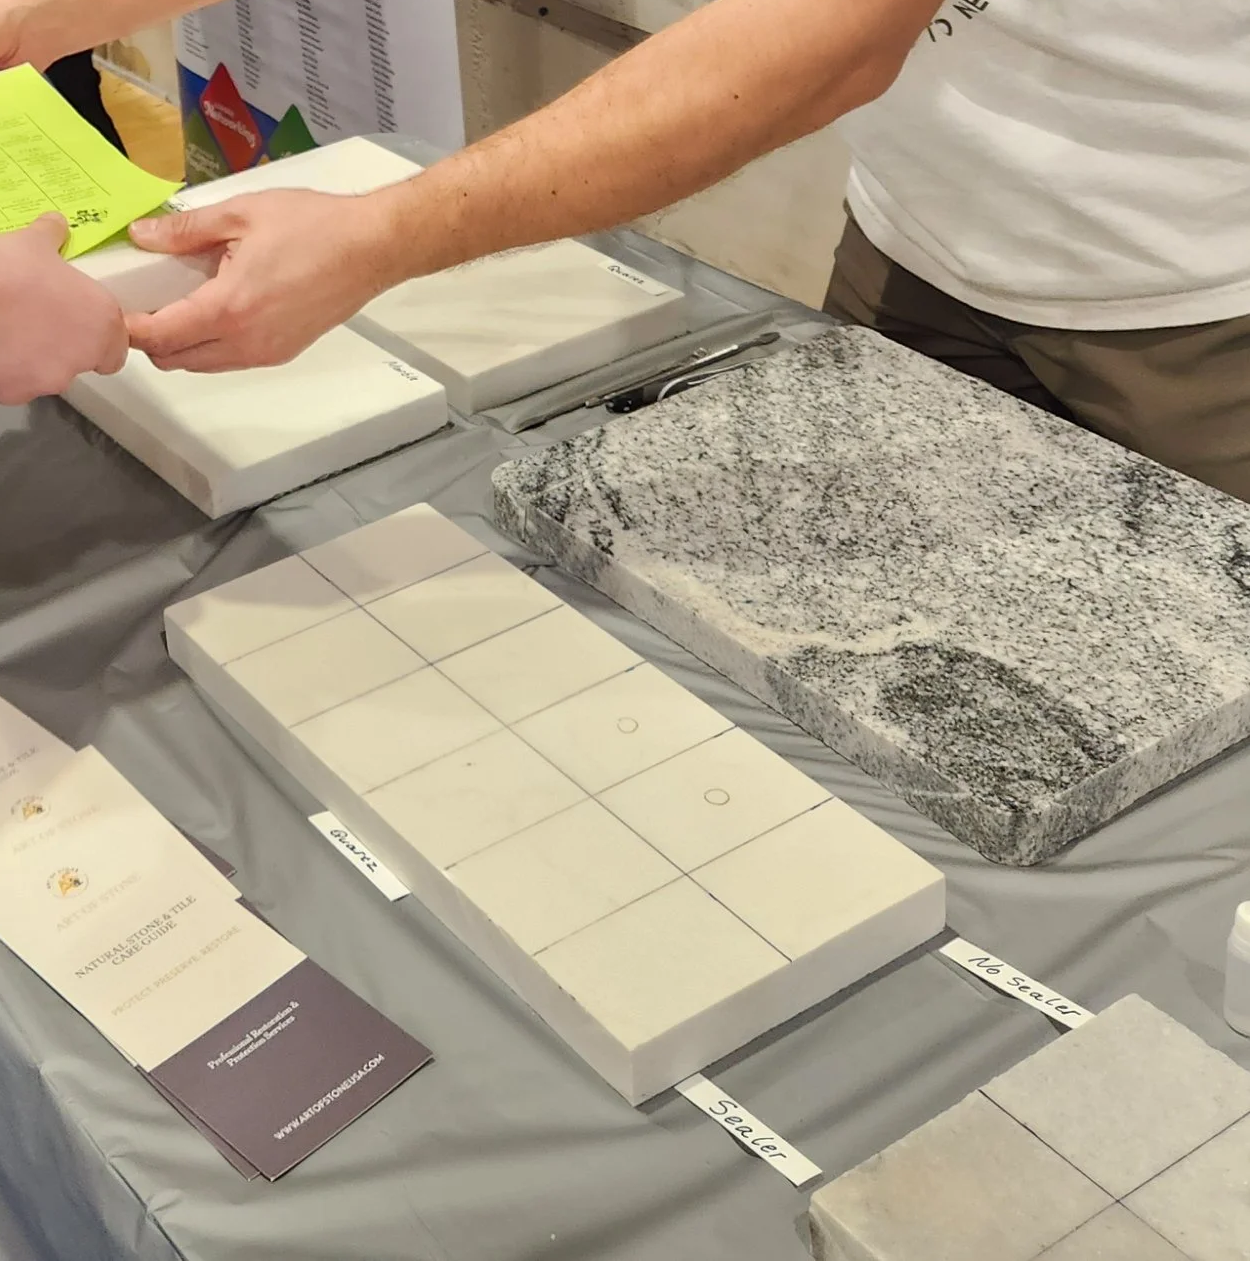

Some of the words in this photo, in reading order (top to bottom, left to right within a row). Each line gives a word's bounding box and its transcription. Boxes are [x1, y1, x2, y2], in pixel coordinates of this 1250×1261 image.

[383, 361, 418, 382] Marble
[55, 912, 81, 933] ART
[80, 901, 99, 916] OF
[98, 873, 142, 903] STONE
[73, 942, 130, 979] NATURAL
[126, 917, 165, 946] STONE
[162, 912, 173, 921] &
[168, 894, 198, 916] TILE
[111, 941, 144, 967] CARE
[140, 919, 179, 947] GUIDE
[199, 924, 242, 957] RESTORE
[967, 957, 1005, 975] No
[206, 1033, 255, 1070] Professional
[249, 1005, 293, 1039] Restoration
[290, 1000, 300, 1010] &
[226, 1036, 267, 1068] Protection
[263, 1014, 297, 1042] Services
[273, 1053, 386, 1141] WWW.ARTOFSTONEUSA.COM
[708, 1099, 788, 1159] Sealer
